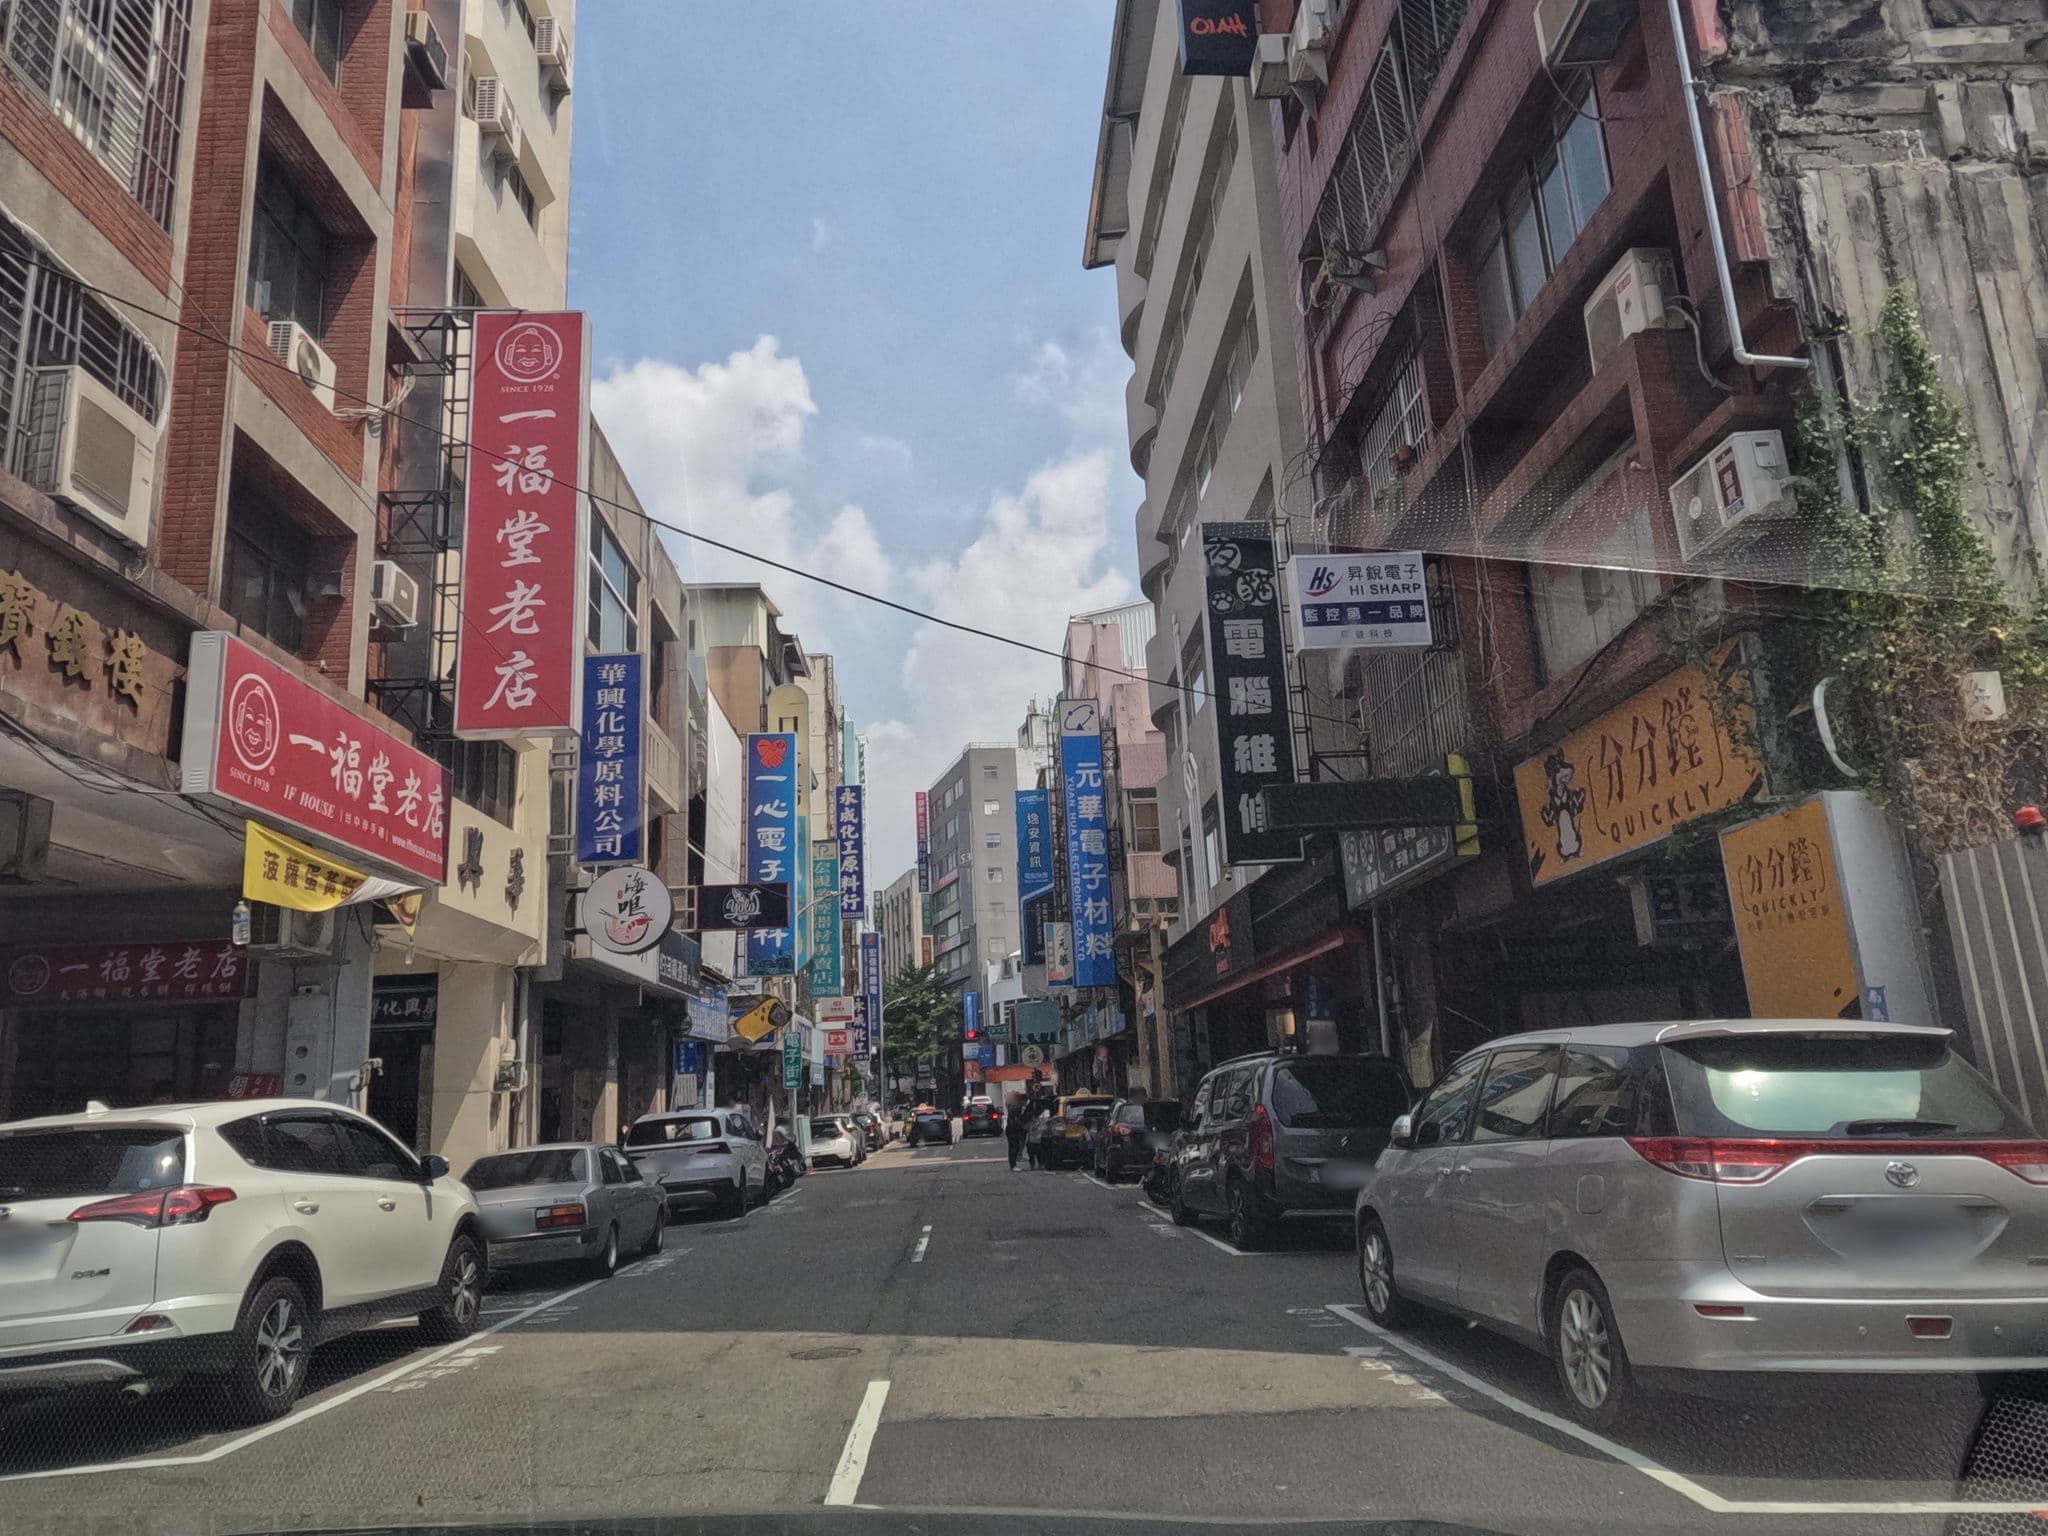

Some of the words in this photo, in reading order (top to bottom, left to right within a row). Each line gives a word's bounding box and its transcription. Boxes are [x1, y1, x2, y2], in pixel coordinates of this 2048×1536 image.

[500, 384, 529, 393] SINCE
[532, 383, 554, 393] 1928
[483, 407, 557, 710] 一福堂老店
[1348, 563, 1419, 581] 昇銳電子
[1349, 585, 1365, 596] HI
[1369, 583, 1422, 595] SHARP
[229, 767, 252, 785] SINCE
[252, 776, 271, 793] 1928
[592, 663, 628, 857] 華興化學原料公司
[283, 784, 297, 800] IF
[299, 791, 336, 819] HOUSE
[288, 730, 443, 840] 一福堂老店
[1610, 781, 1711, 844] QUICKLY
[753, 774, 789, 948] 一心電子料
[1075, 761, 1113, 961] 元華電子材料
[1752, 889, 1817, 916] QUICKLY
[58, 945, 238, 983] 一福堂老店
[785, 1033, 800, 1079] 電子街
